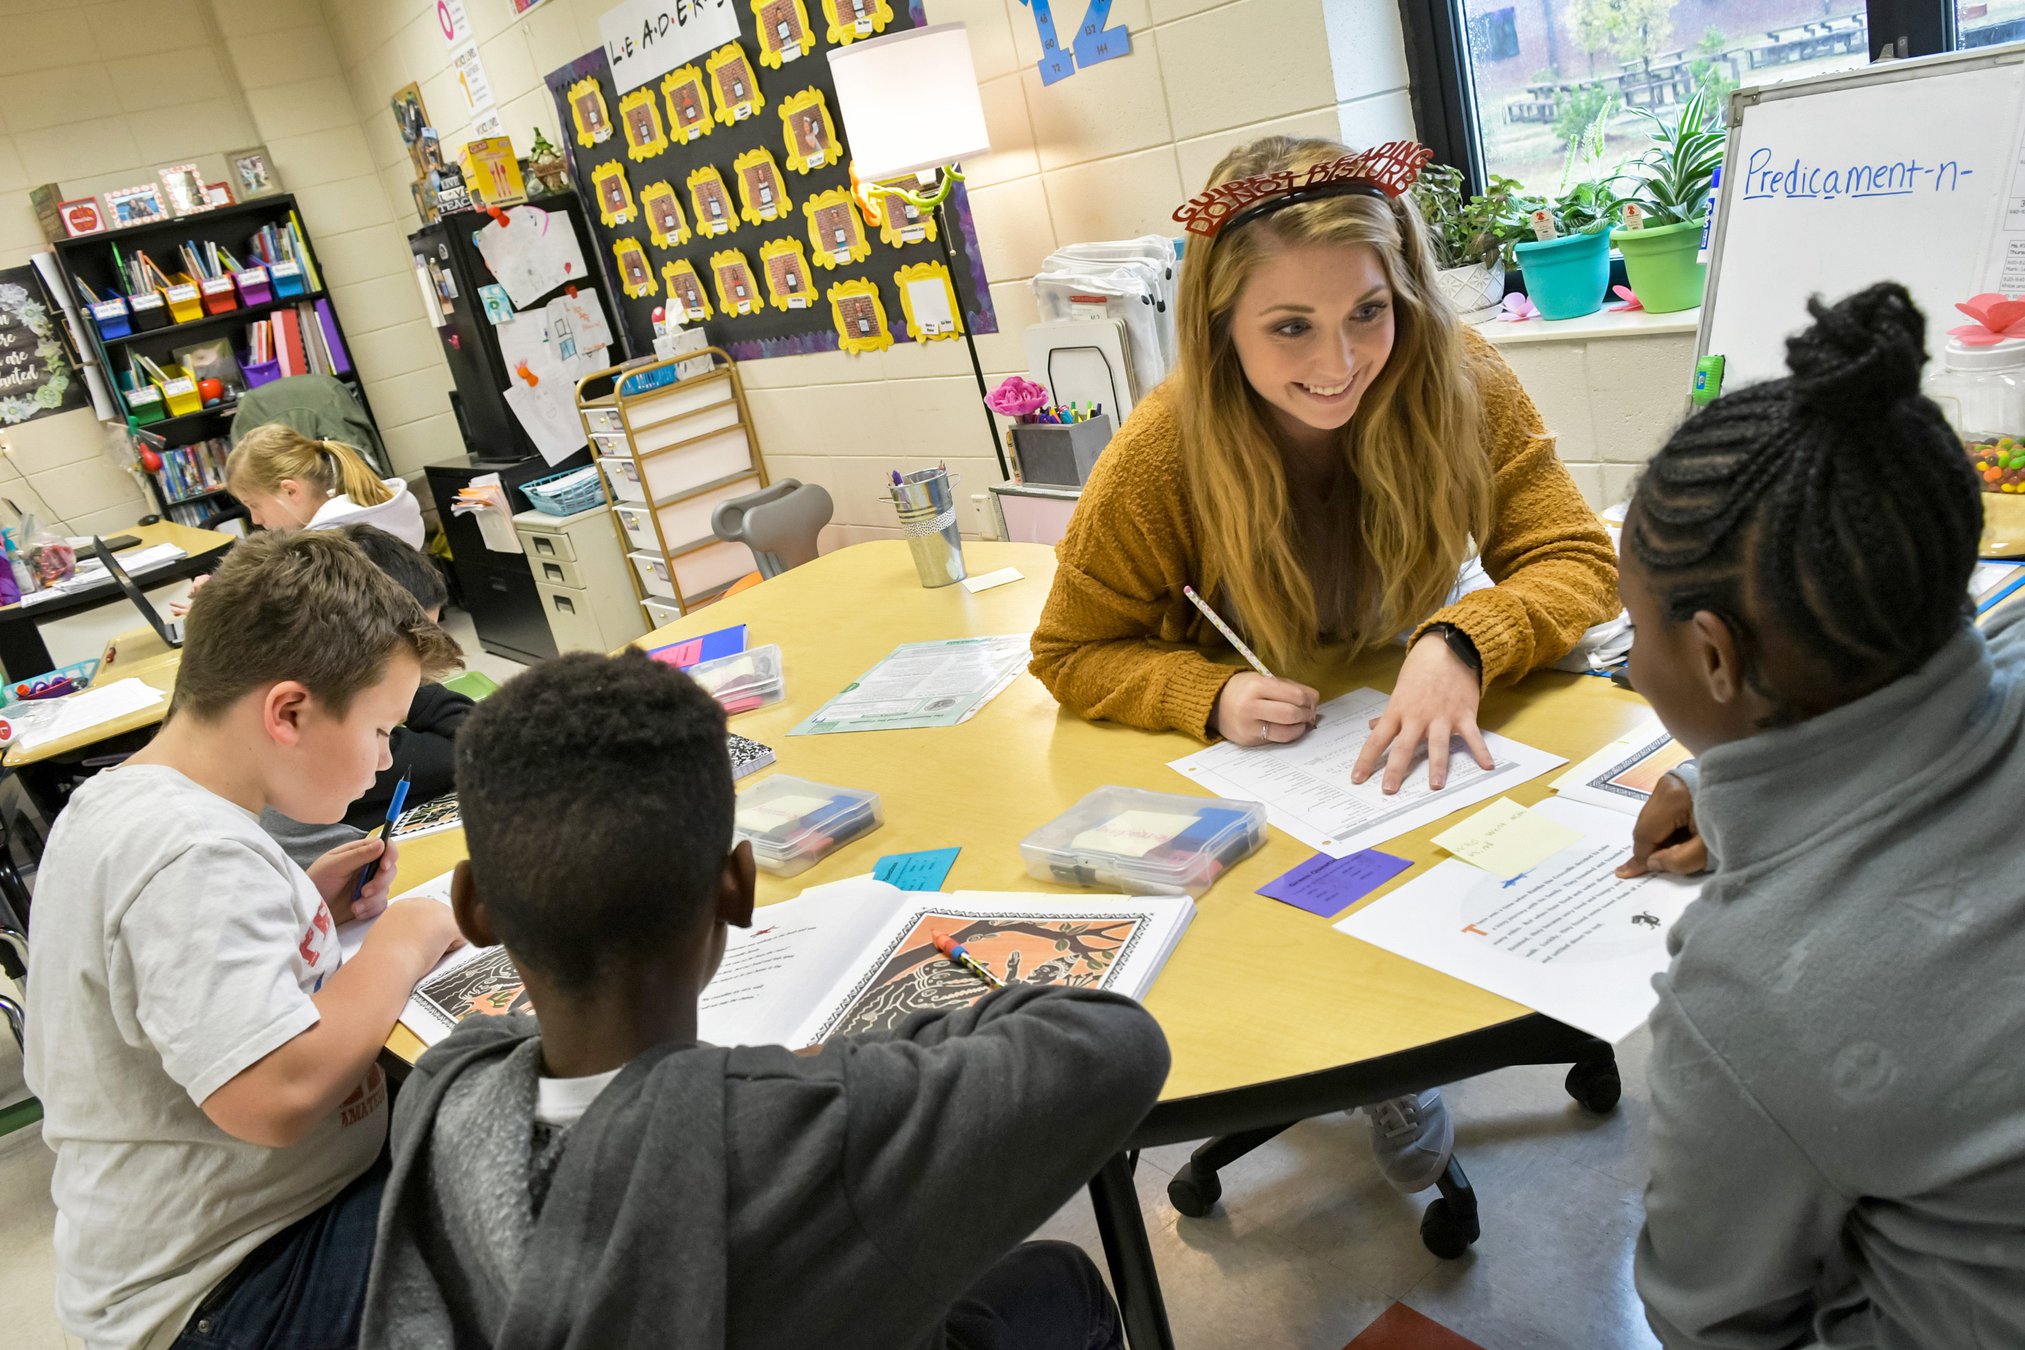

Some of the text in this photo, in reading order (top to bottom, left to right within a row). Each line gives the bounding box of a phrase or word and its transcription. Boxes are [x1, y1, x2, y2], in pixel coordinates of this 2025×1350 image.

[1084, 24, 1096, 36] 132
[1045, 38, 1055, 50] 60
[1096, 43, 1108, 56] 144
[1052, 63, 1062, 73] 72
[441, 177, 460, 190] LIVE
[1172, 140, 1435, 223] GUIDED READING
[1185, 158, 1419, 238] DO NOT DISTURB
[438, 198, 470, 214] TEAC
[0, 364, 38, 387] anted
